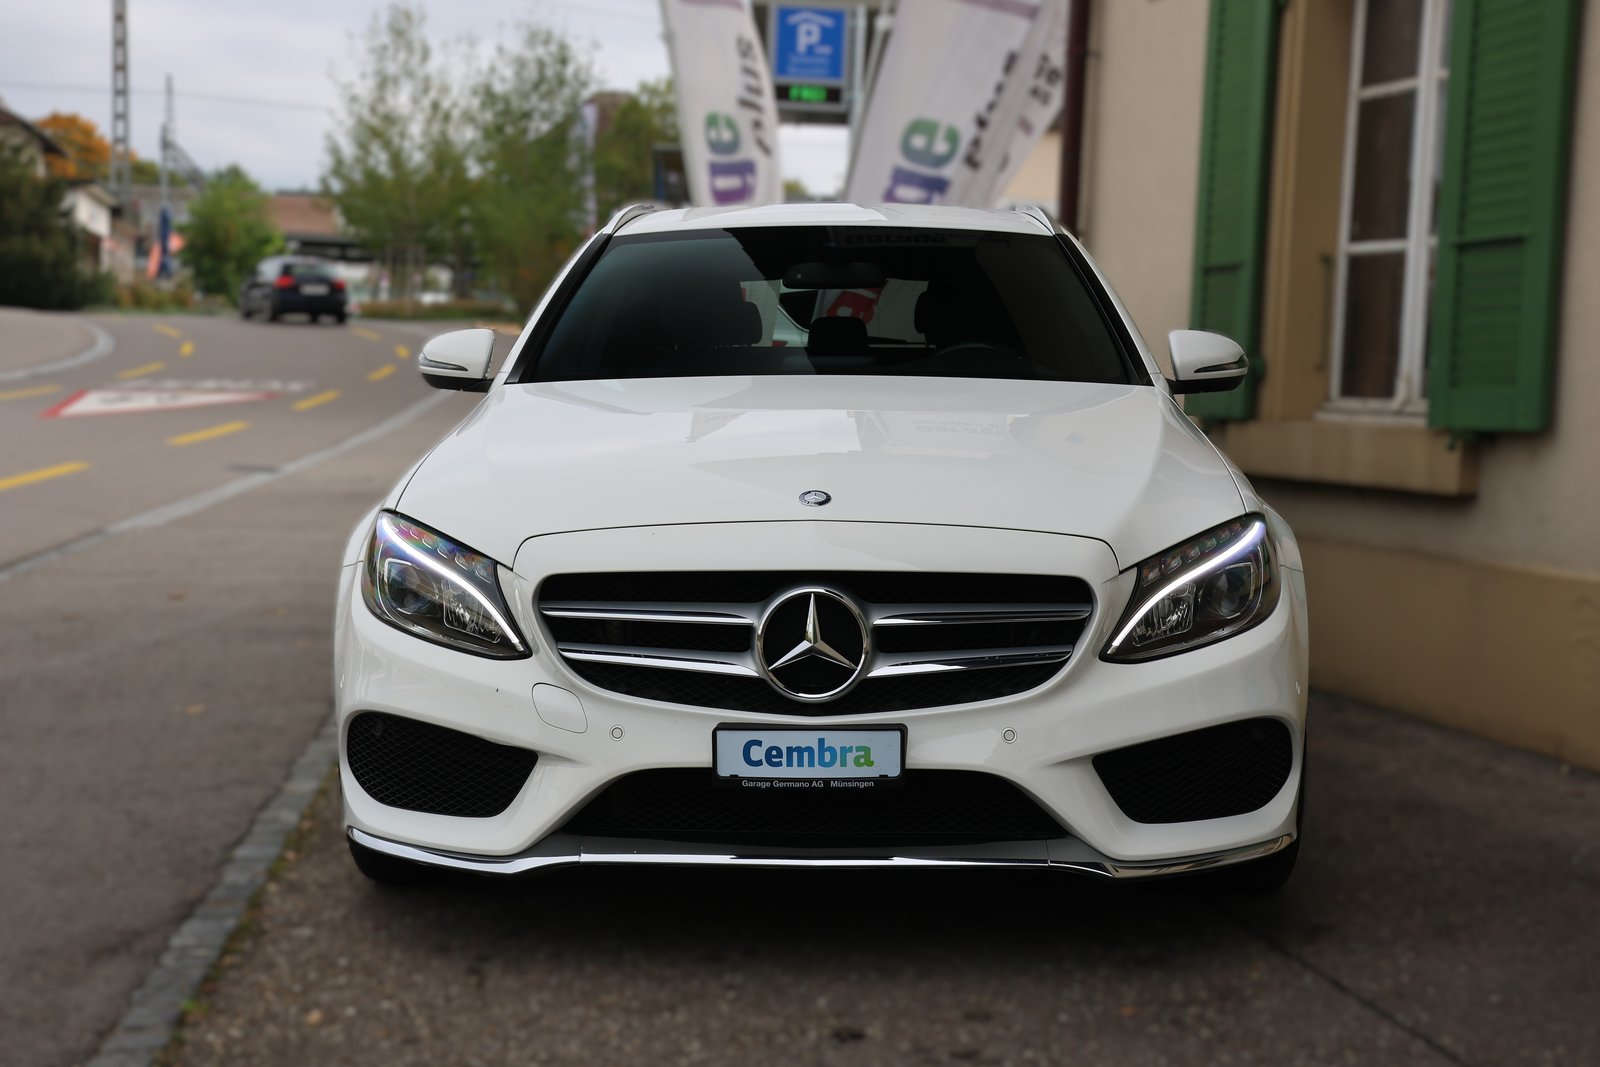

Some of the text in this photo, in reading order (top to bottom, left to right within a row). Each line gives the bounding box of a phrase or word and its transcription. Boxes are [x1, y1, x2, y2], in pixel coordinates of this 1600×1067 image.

[742, 738, 875, 768] Cembra
[742, 779, 875, 789] Garage Germano AG Münsingen
